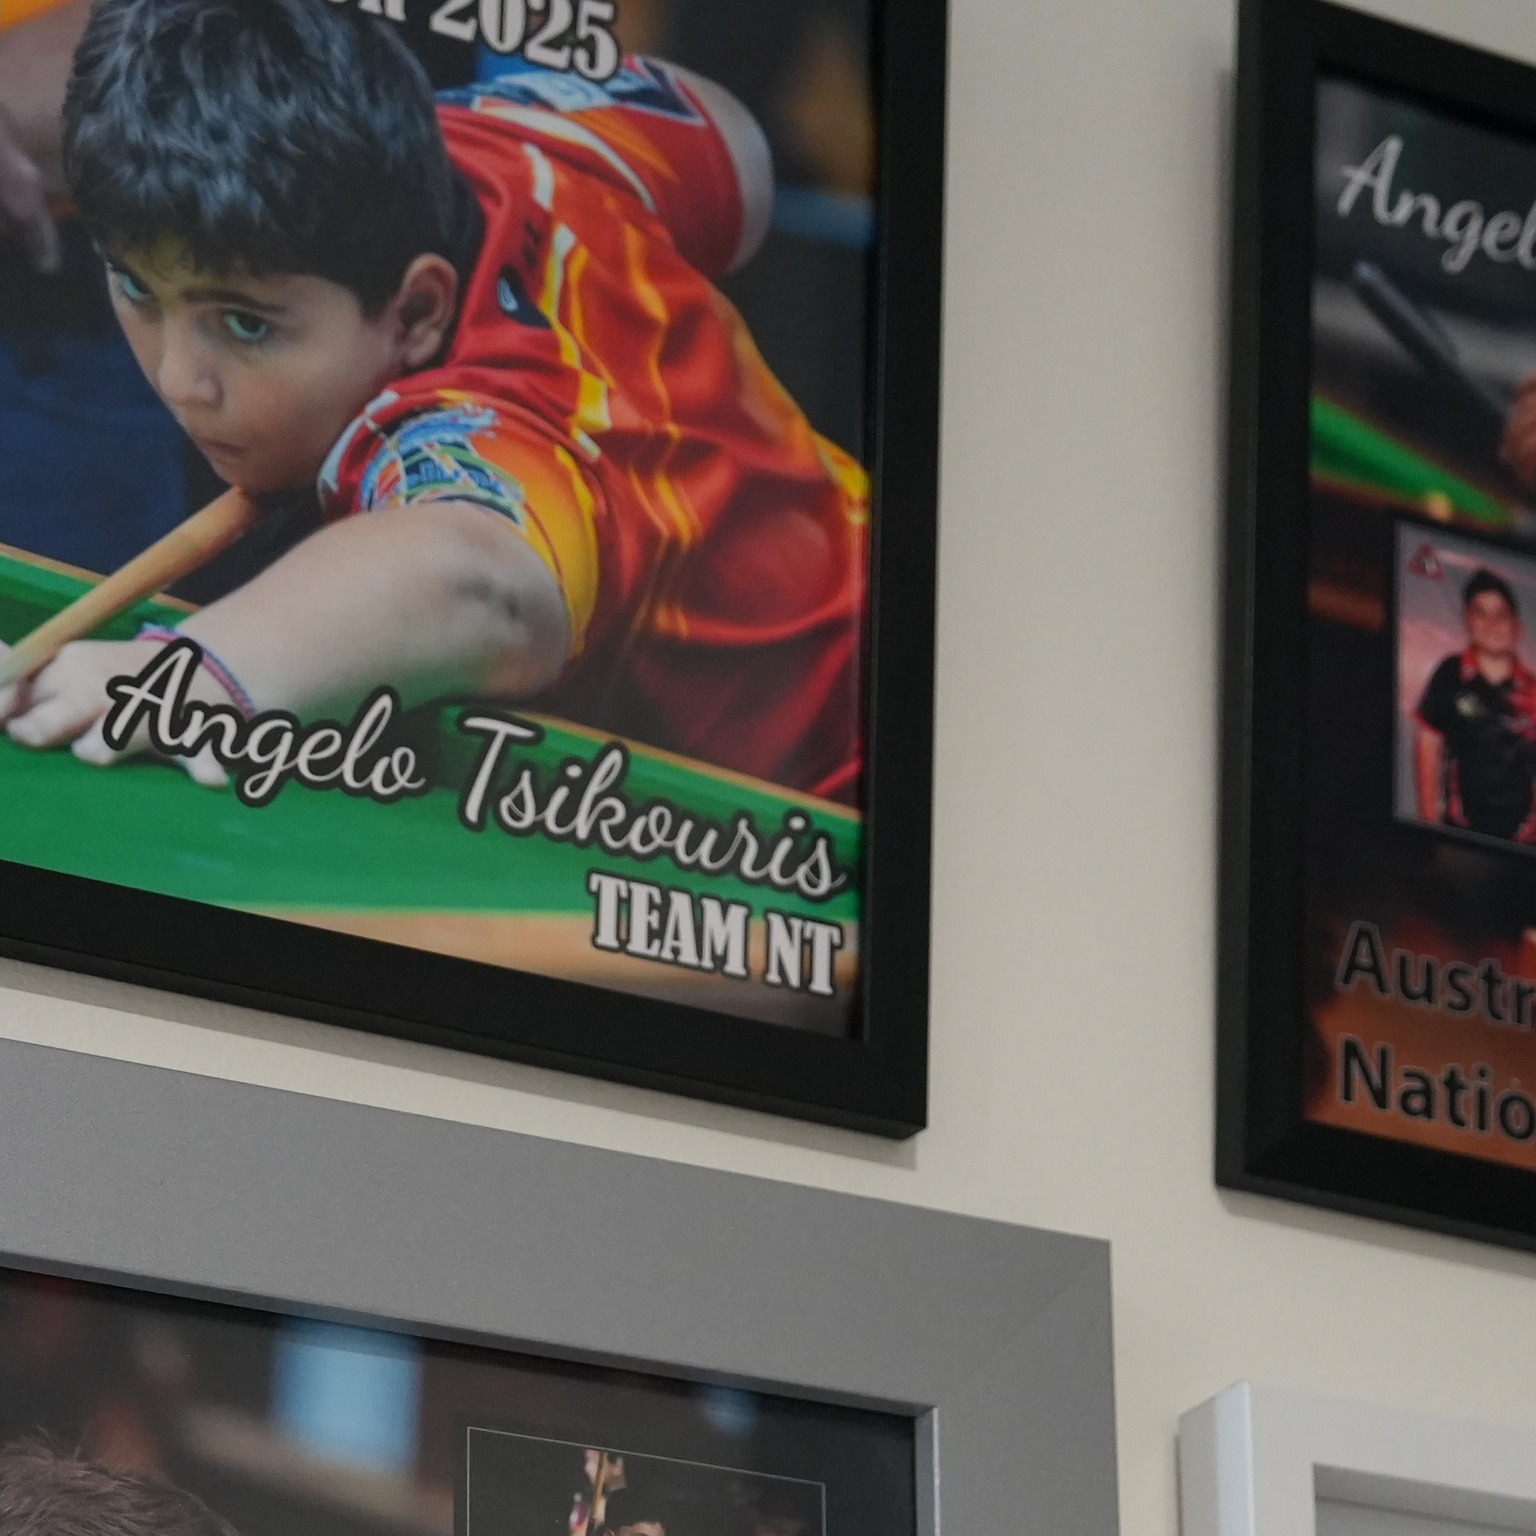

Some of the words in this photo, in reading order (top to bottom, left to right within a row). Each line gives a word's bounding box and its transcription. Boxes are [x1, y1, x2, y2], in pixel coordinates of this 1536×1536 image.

[429, 0, 618, 81] 2025
[111, 645, 426, 799] Angelo
[464, 716, 848, 898] Tsikouris
[589, 873, 748, 977] TEAM
[766, 912, 842, 994] NT
